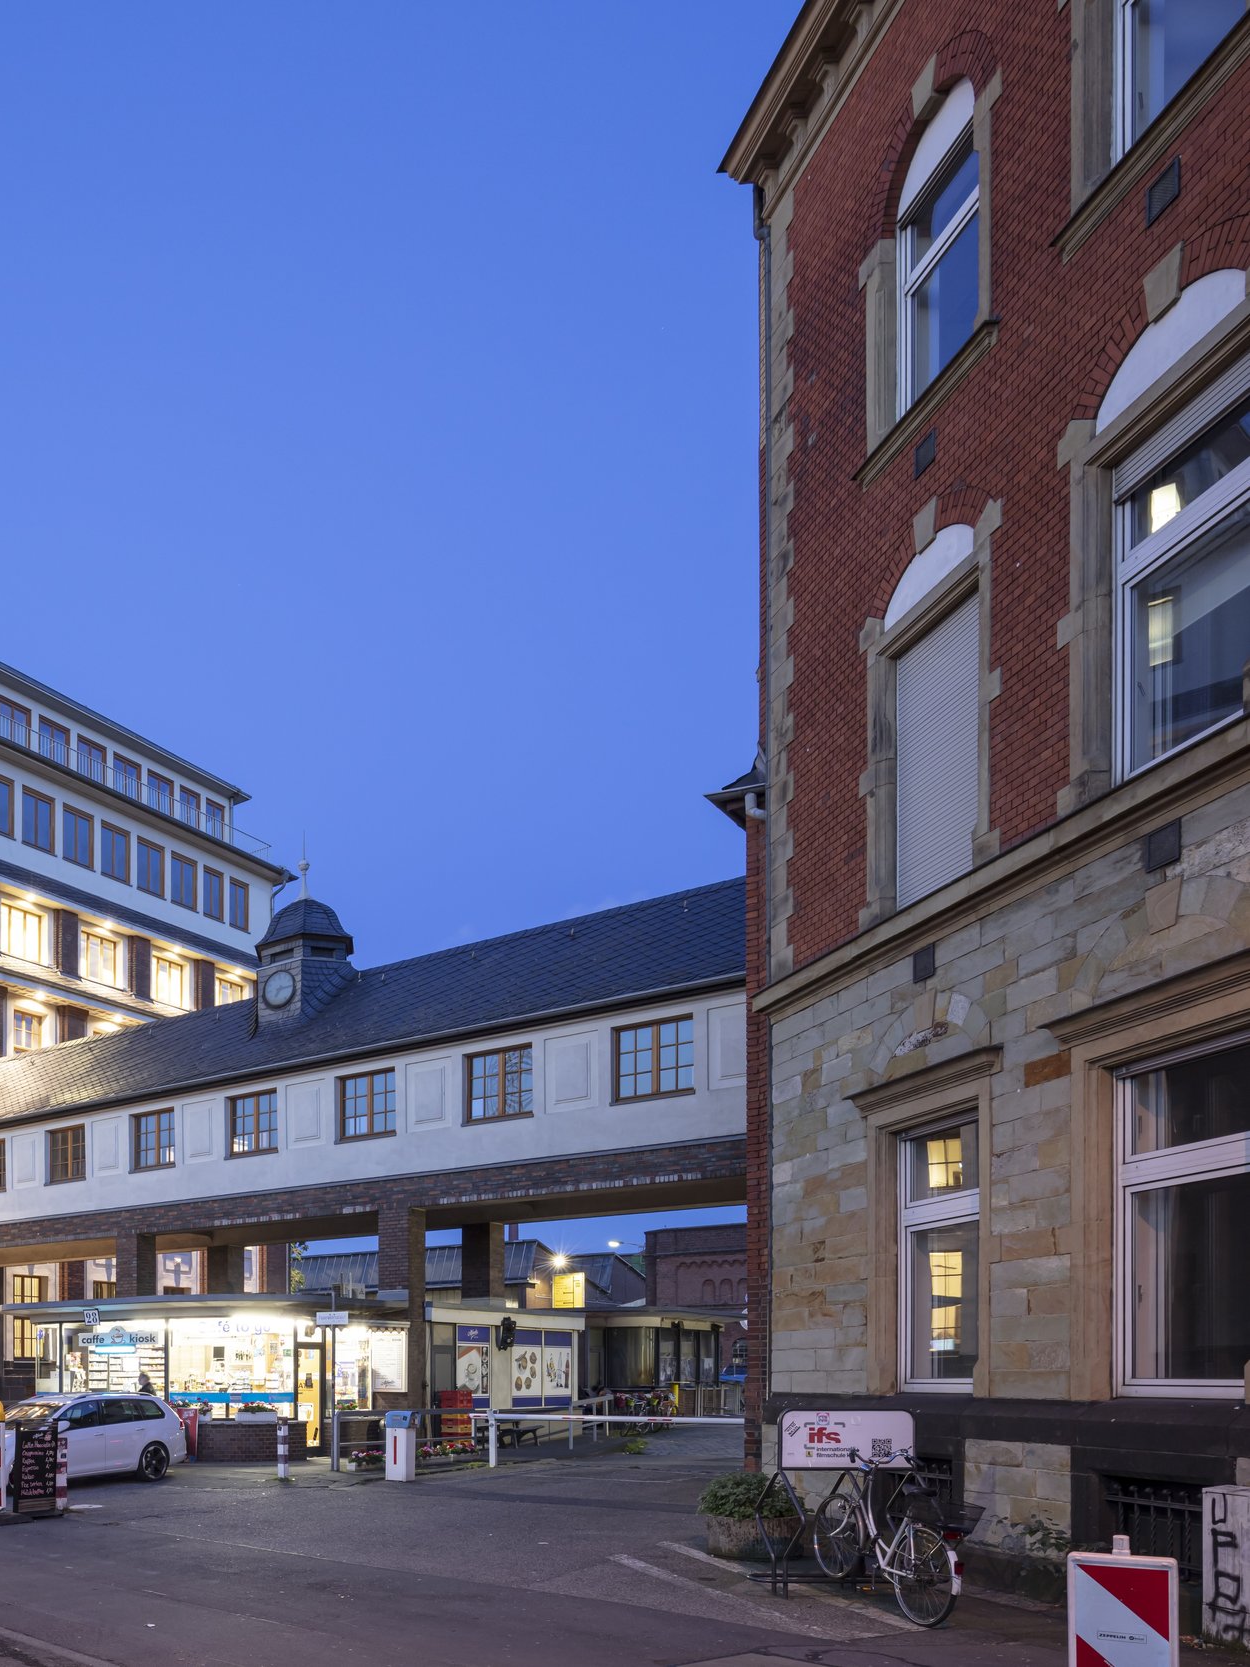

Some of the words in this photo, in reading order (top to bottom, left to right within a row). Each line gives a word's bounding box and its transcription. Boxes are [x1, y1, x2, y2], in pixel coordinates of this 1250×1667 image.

[85, 1311, 98, 1324] 28
[81, 1334, 105, 1344] caffe
[129, 1333, 156, 1343] kiosk
[808, 1427, 841, 1443] ifs
